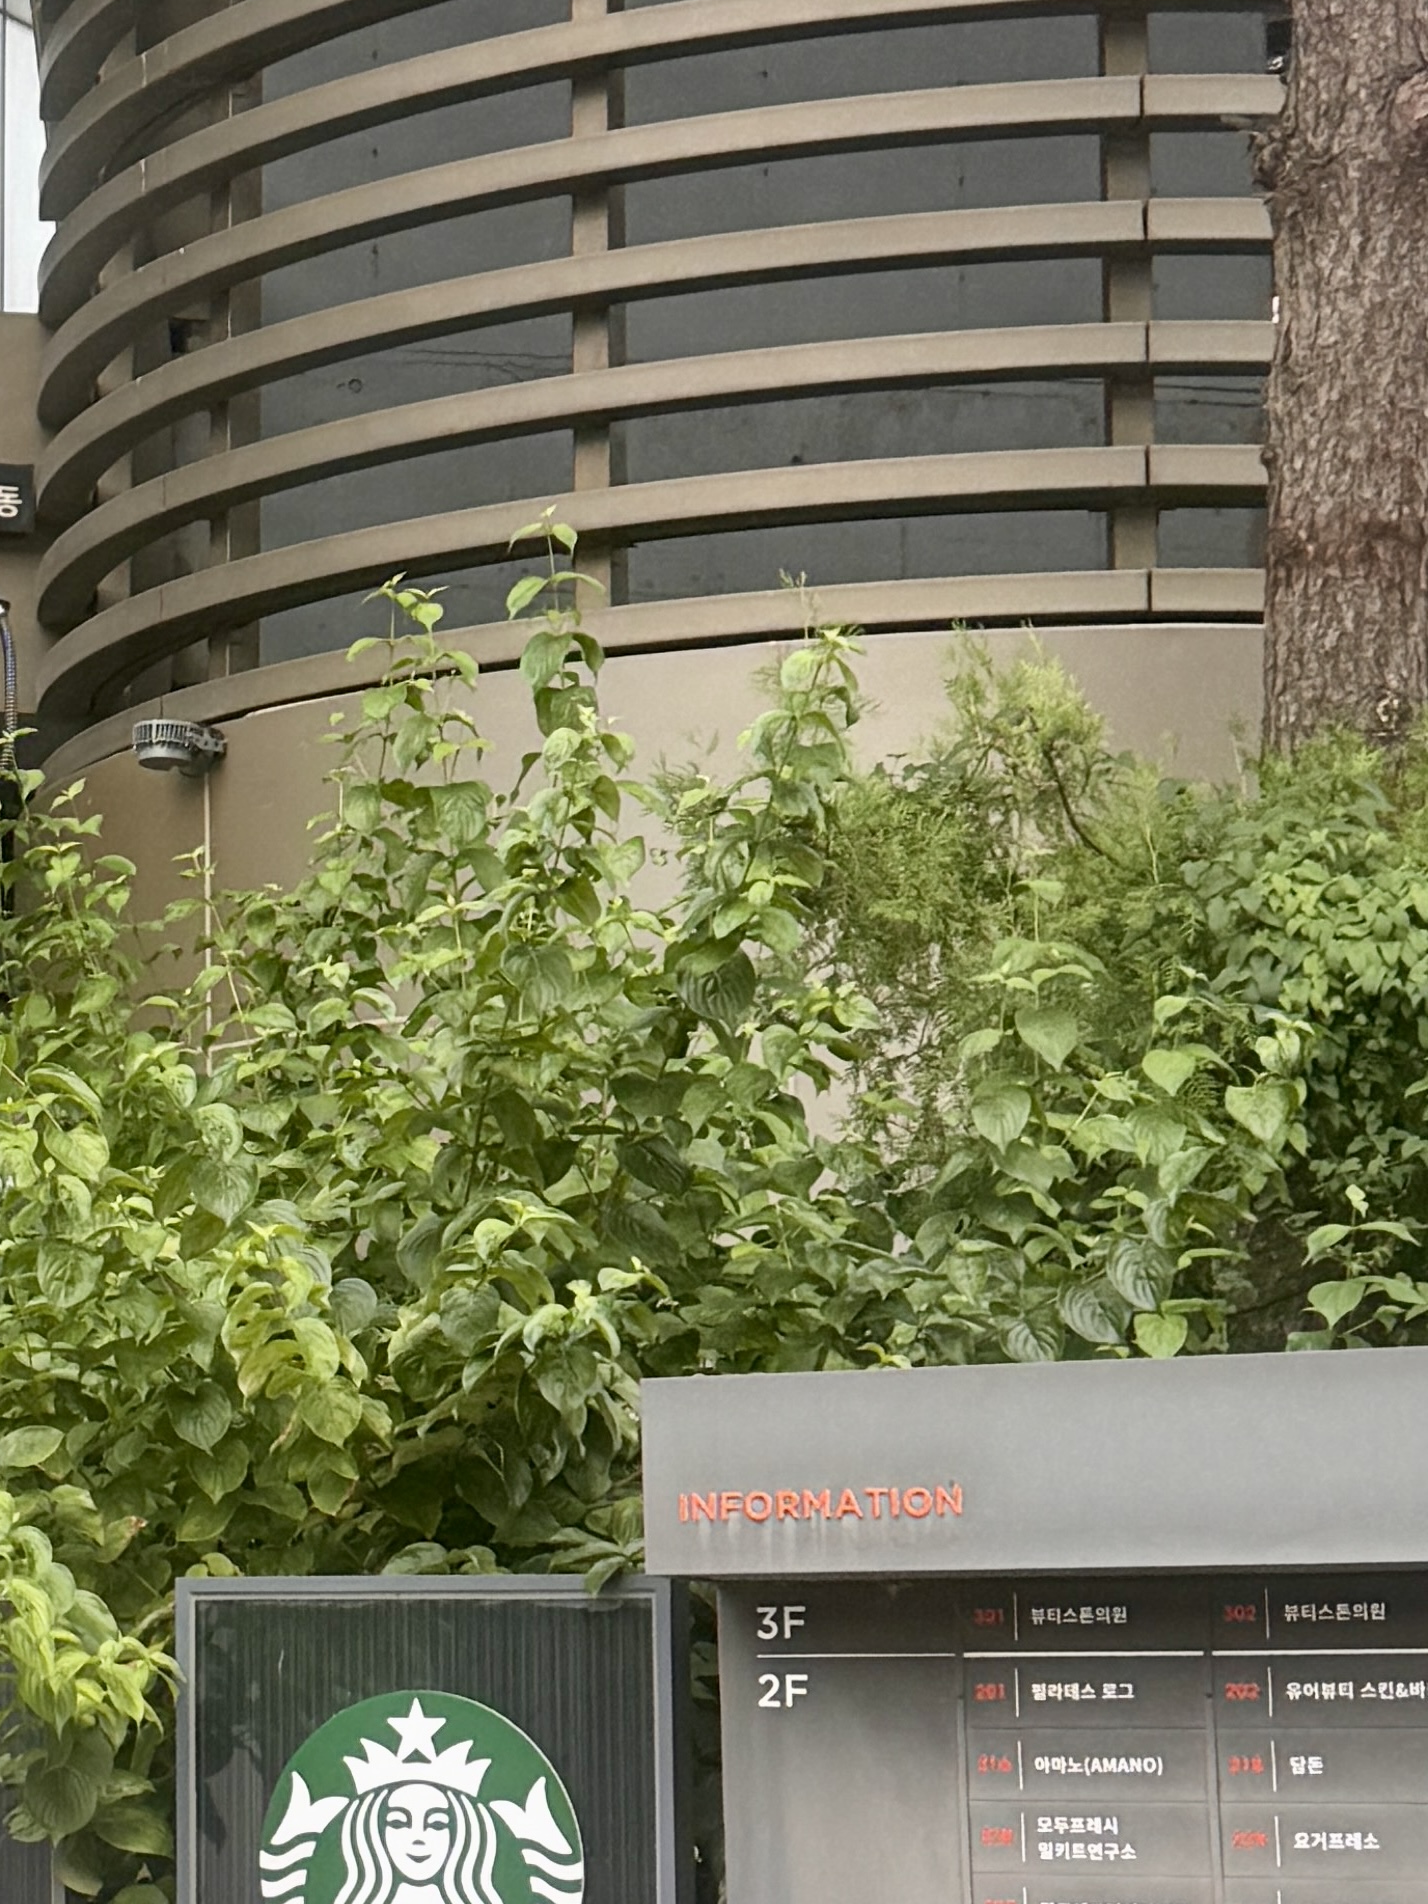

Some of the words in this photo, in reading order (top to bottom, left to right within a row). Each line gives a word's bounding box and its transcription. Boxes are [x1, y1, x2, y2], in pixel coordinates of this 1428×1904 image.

[679, 1484, 964, 1523] INFORMATION
[756, 1606, 806, 1640] 3F
[757, 1674, 808, 1707] 2F
[1294, 1832, 1380, 1851] 요거프레소
